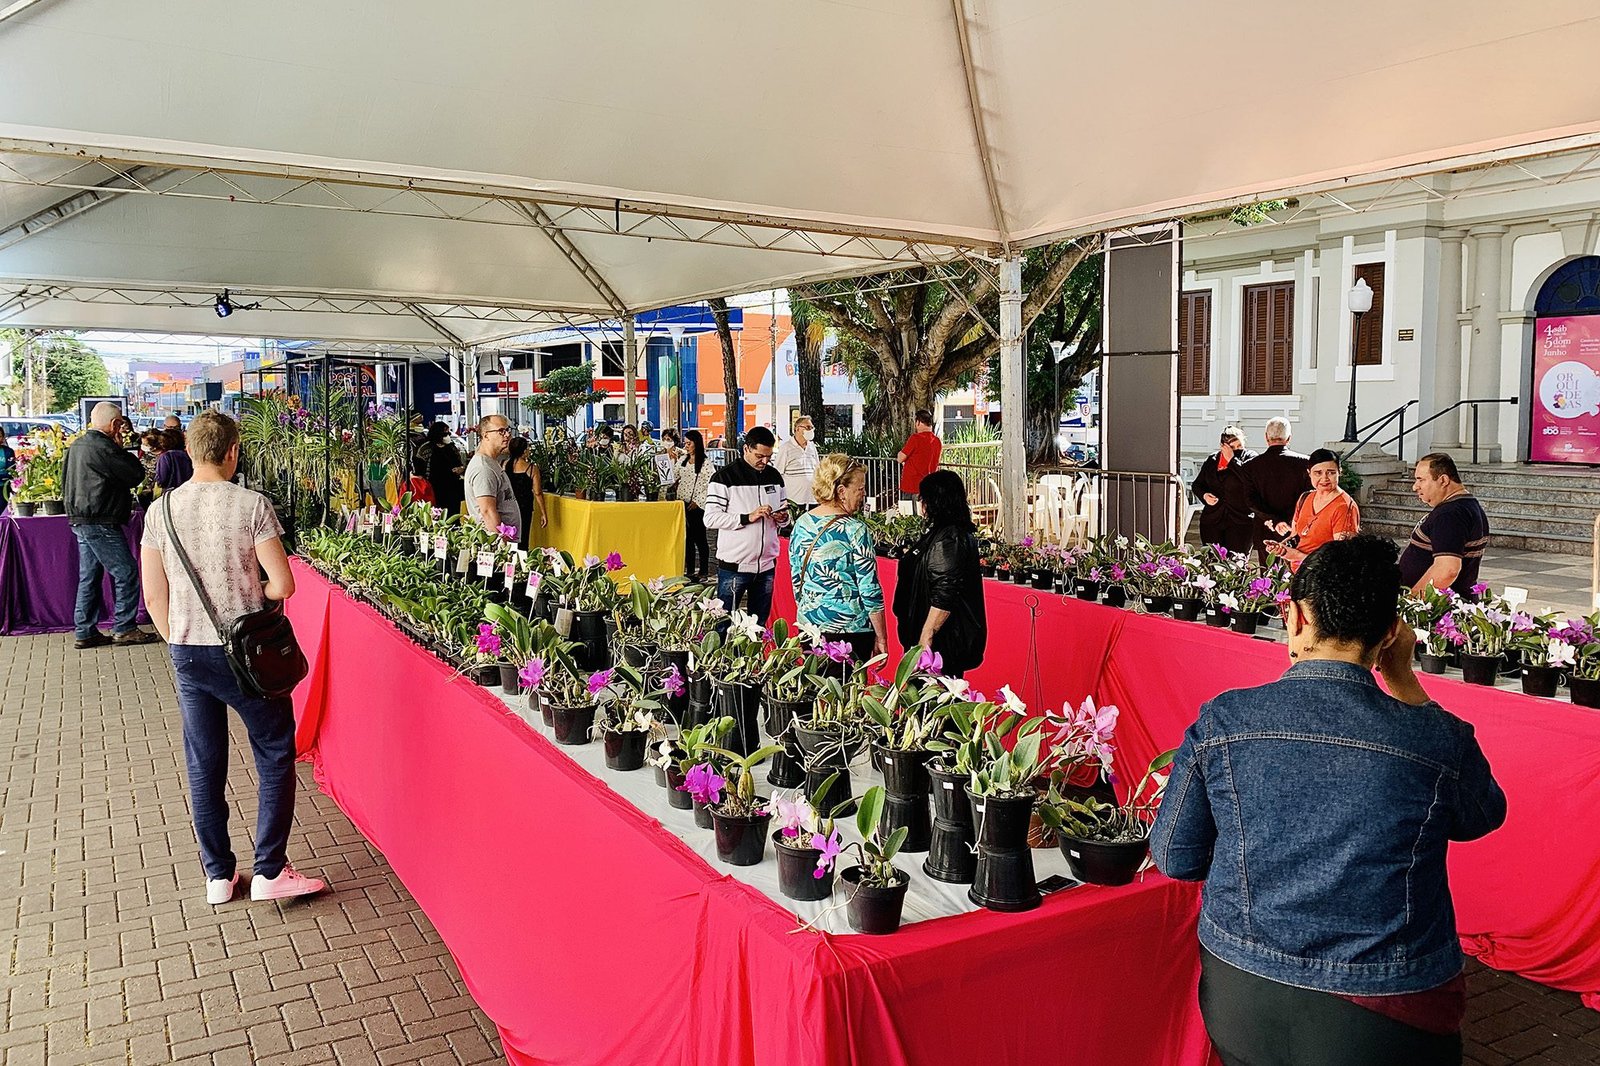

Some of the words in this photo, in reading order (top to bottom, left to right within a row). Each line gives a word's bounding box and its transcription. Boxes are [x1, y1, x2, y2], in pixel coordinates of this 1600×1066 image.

[1544, 325, 1553, 336] 4
[1544, 337, 1553, 348] 5
[1556, 373, 1573, 381] OR
[1565, 391, 1581, 399] DE
